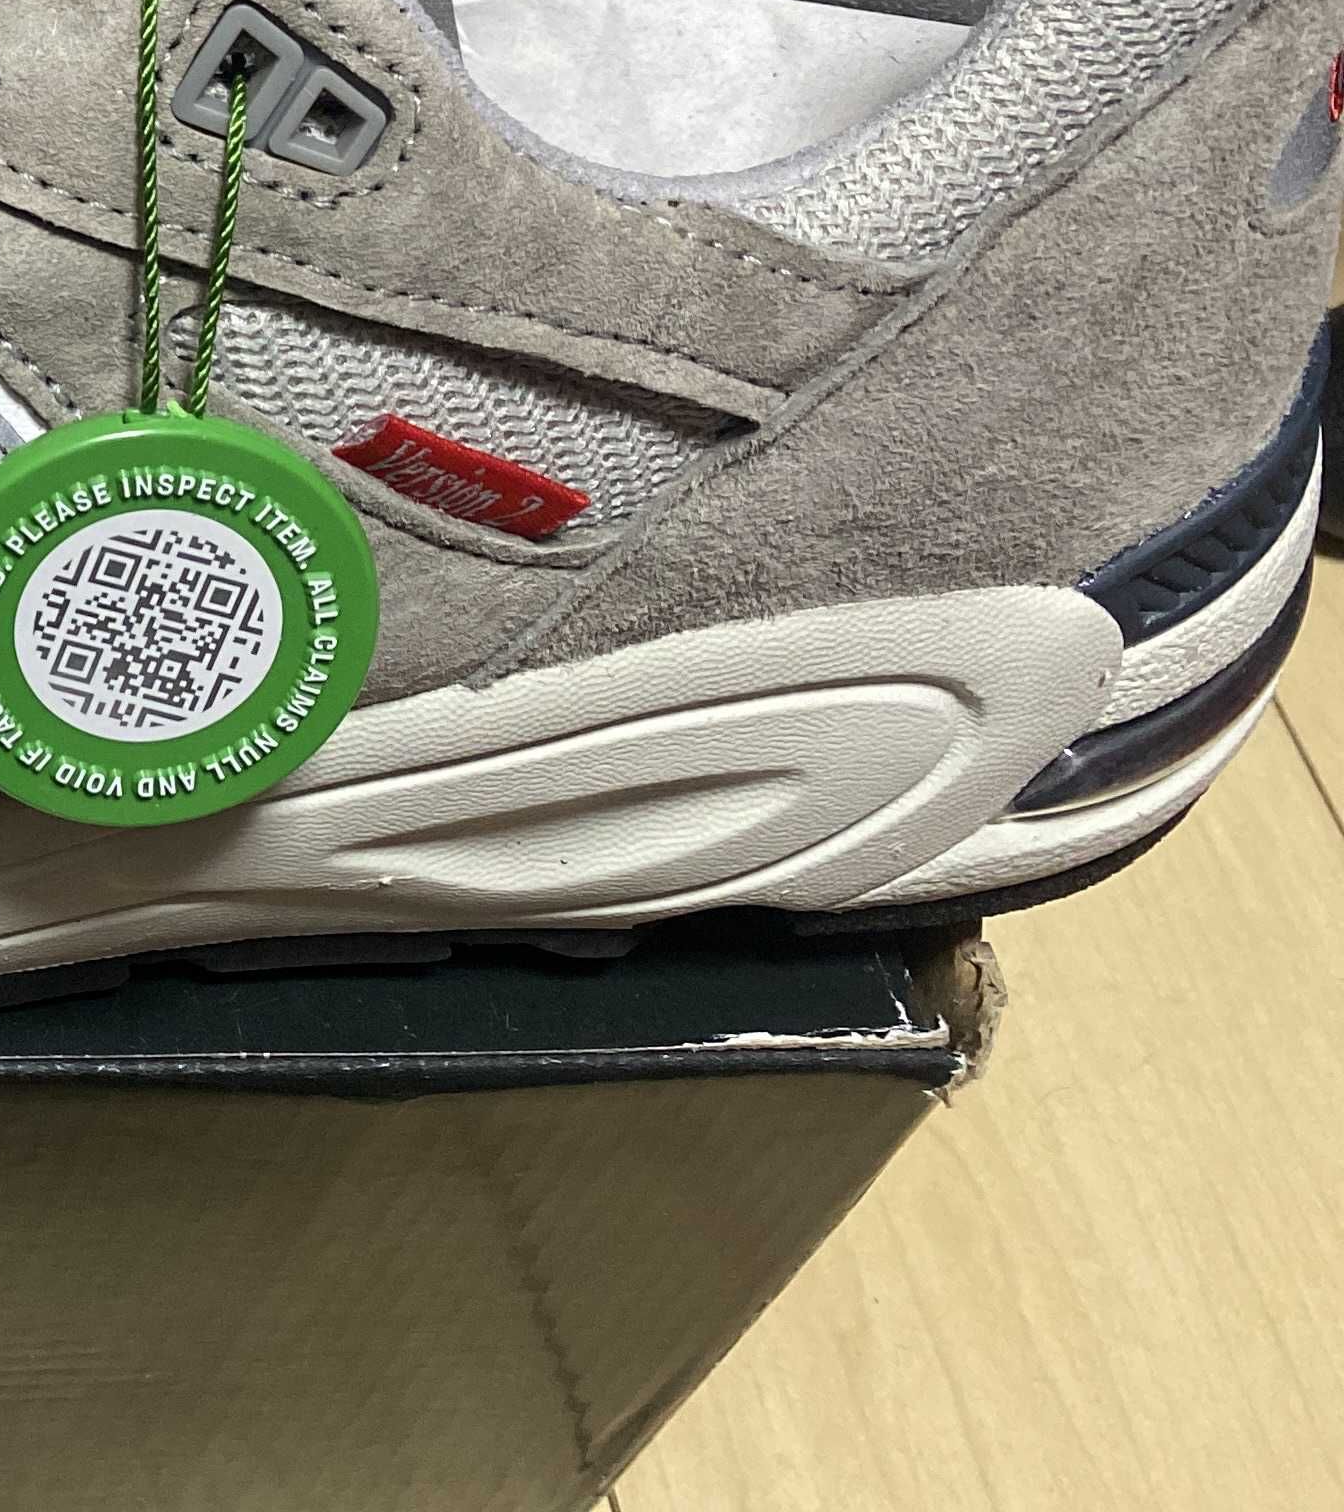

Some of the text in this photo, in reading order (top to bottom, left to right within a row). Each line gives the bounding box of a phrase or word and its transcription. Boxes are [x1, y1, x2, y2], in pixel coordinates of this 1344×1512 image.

[121, 473, 255, 511] INSPECT
[5, 481, 112, 556] PLEASE
[254, 502, 317, 570] ITEM.
[307, 577, 339, 625] ALL
[275, 635, 338, 732] CLAIMS
[18, 746, 53, 772] IF
[206, 730, 279, 780] NULL
[55, 763, 123, 797] VOID
[137, 769, 197, 798] AND
